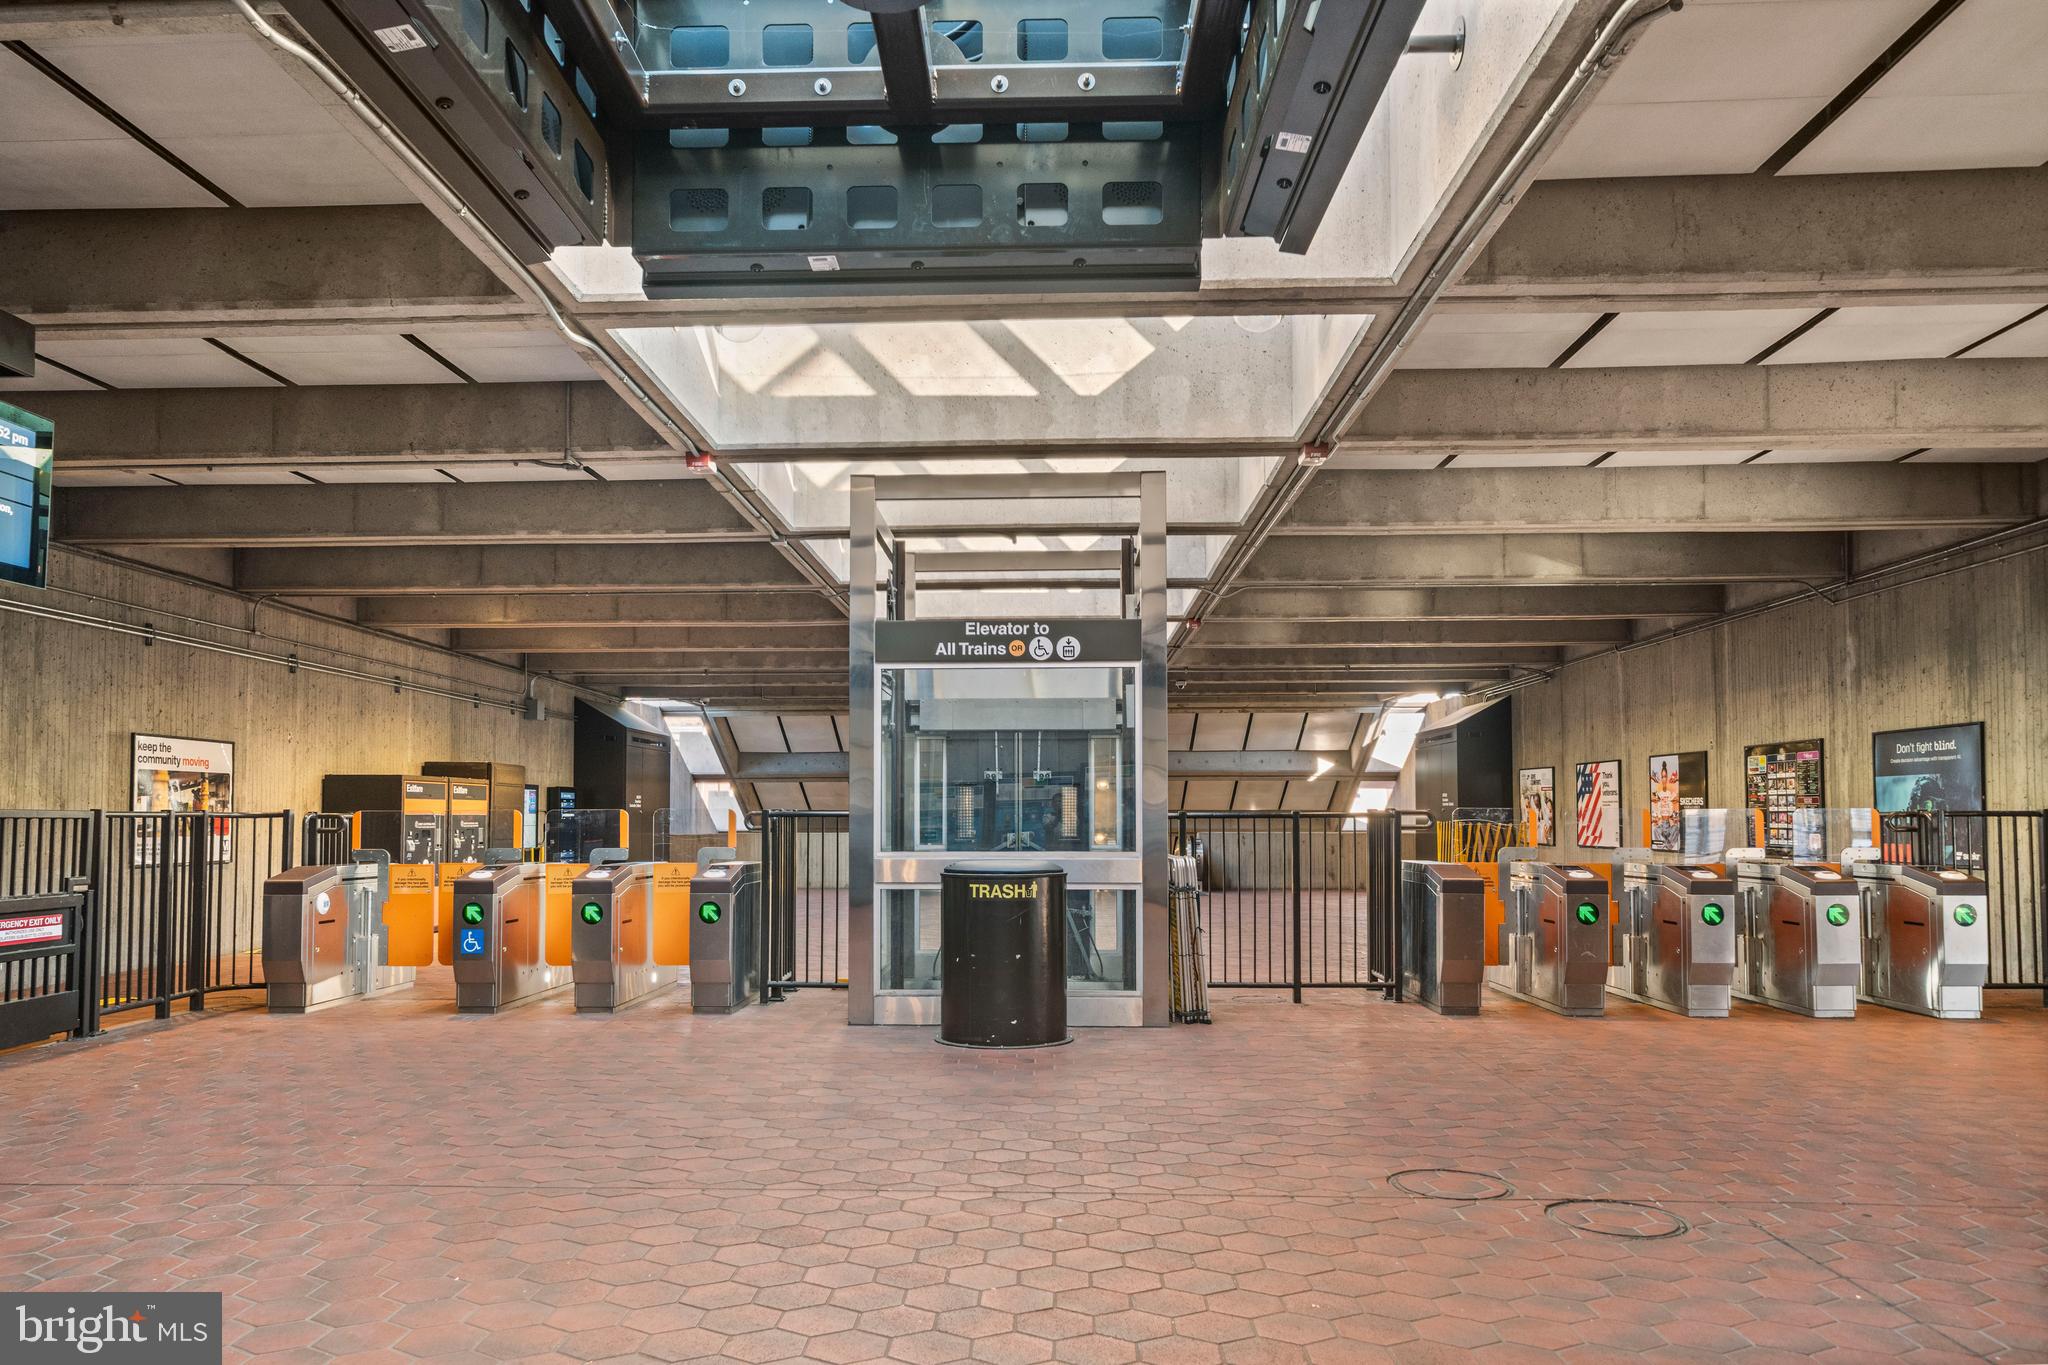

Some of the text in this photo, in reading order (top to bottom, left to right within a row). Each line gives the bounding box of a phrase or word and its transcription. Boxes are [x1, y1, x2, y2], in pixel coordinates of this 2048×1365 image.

[12, 433, 28, 446] pm
[965, 622, 1049, 636] Elevator to
[935, 642, 1007, 656] All Trains
[137, 741, 172, 754] keep the
[1896, 739, 1957, 754] Don't fight blind.
[137, 755, 210, 769] community moving
[1680, 797, 1704, 806] SKECHERS
[969, 883, 1026, 898] TRASH
[45, 917, 62, 925] ONLY
